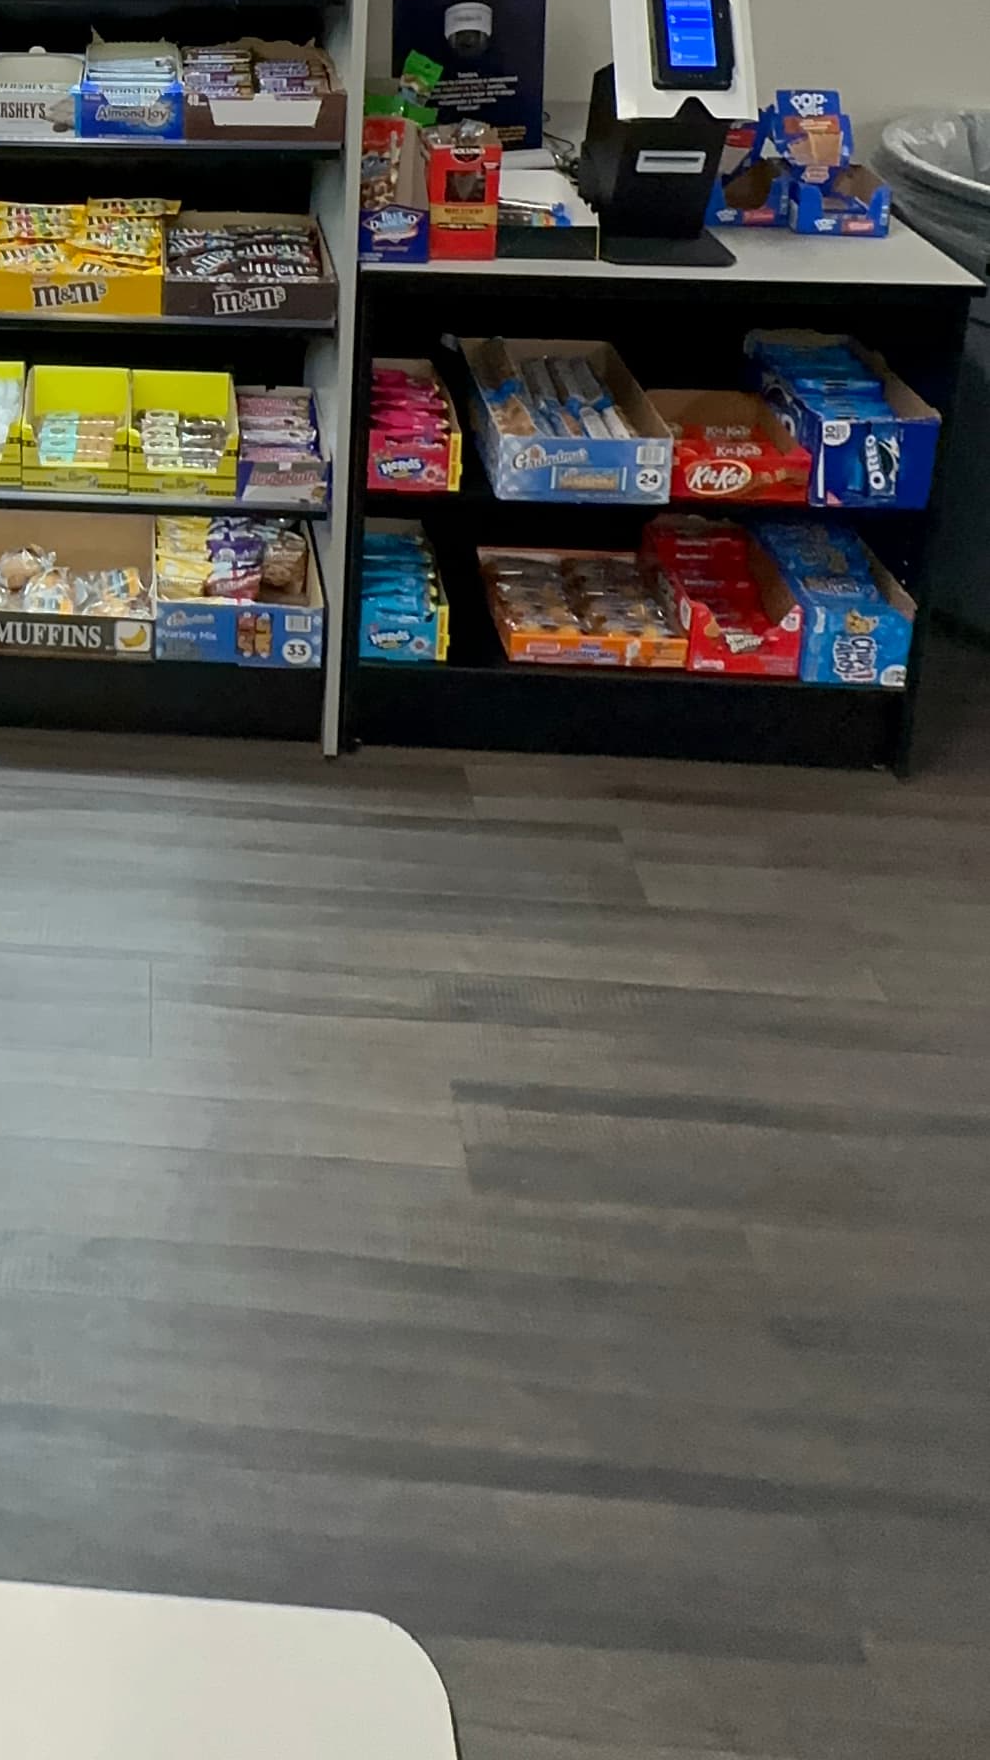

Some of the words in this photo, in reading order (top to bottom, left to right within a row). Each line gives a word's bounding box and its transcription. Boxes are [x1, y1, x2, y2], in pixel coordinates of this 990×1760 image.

[96, 104, 146, 121] Almond
[148, 105, 170, 125] Joy
[32, 281, 107, 308] m&m's
[214, 287, 286, 314] m&m's
[865, 433, 886, 490] OREO
[639, 473, 659, 485] 24
[286, 643, 308, 657] 33
